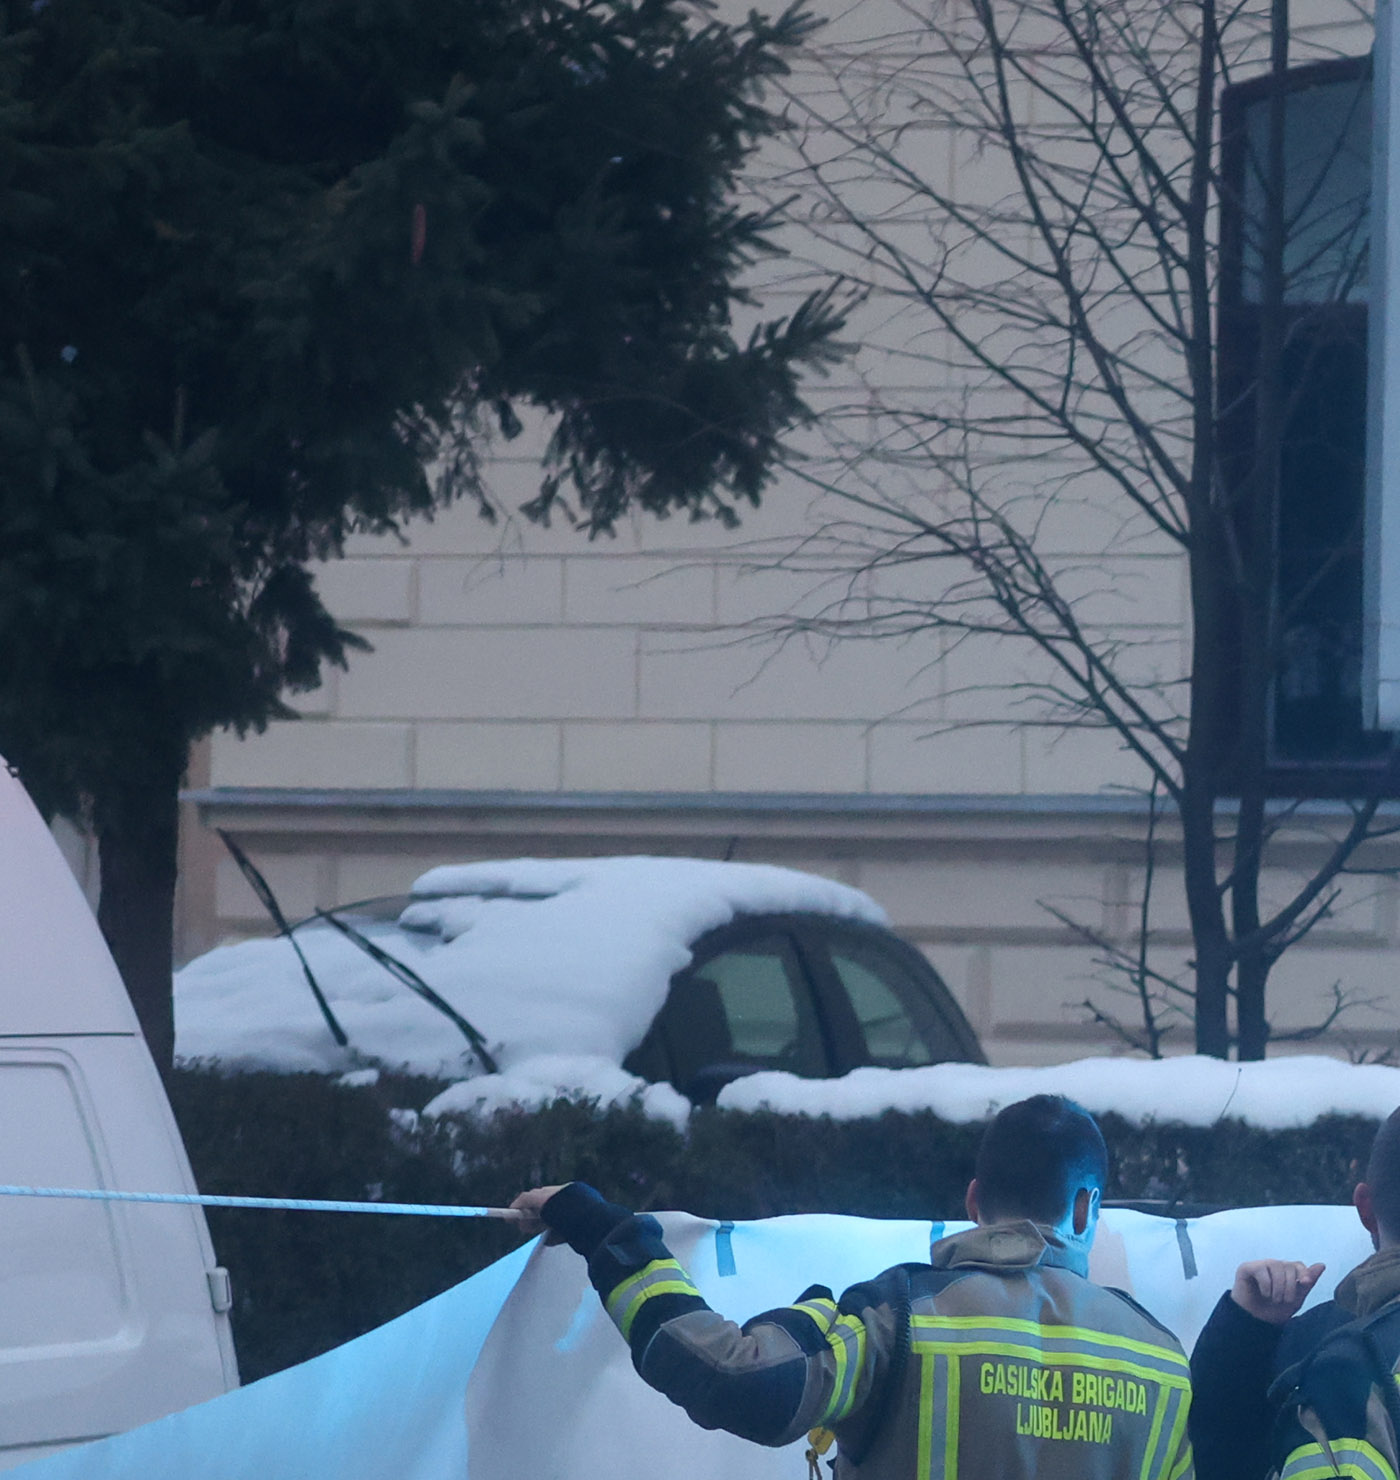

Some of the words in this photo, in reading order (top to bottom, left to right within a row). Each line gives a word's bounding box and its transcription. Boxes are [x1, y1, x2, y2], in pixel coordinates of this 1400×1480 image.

[980, 1362, 1064, 1403] GASILSKA
[1072, 1372, 1147, 1416] BRIGADA
[1016, 1403, 1113, 1444] LJUBLJANA
